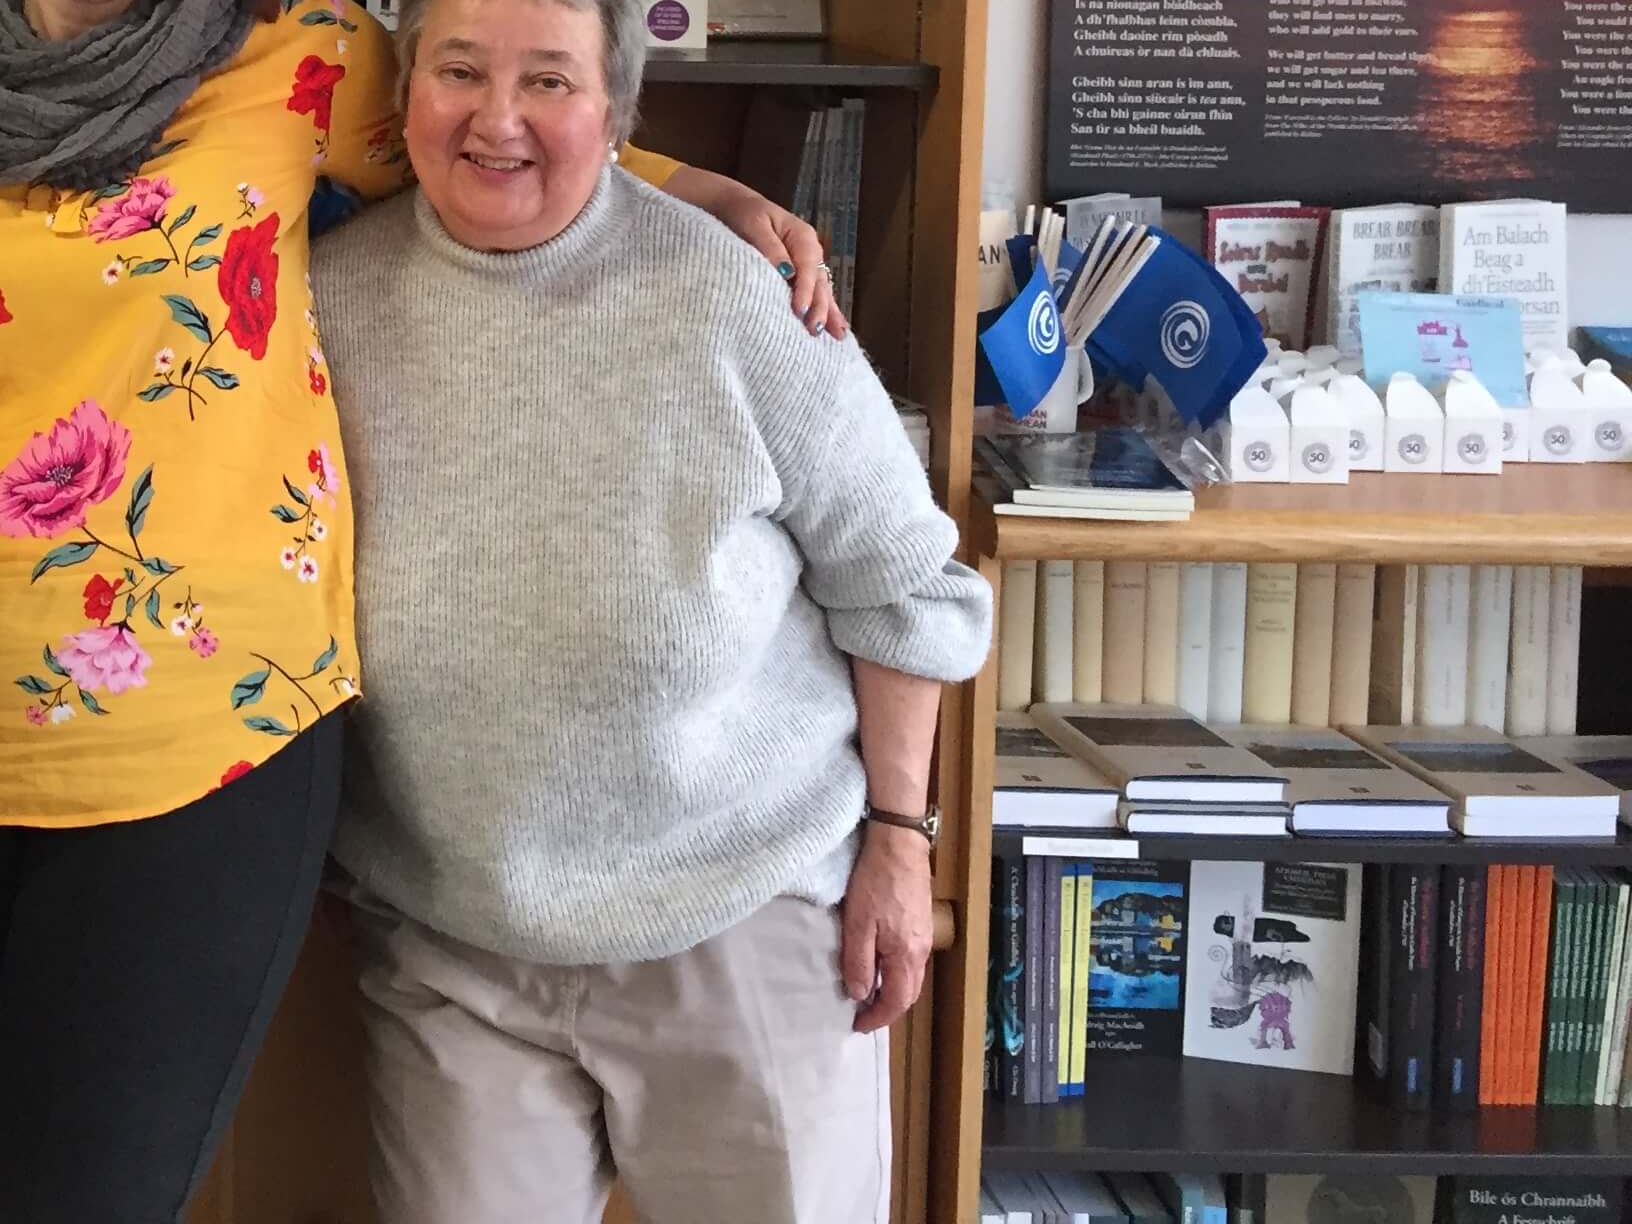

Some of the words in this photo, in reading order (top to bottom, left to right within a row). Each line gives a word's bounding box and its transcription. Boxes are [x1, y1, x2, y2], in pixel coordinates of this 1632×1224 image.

[1089, 0, 1103, 9] na
[1075, 14, 1084, 25] A
[1073, 46, 1083, 56] A
[1464, 227, 1492, 246] Am
[1496, 224, 1549, 244] Balach
[1474, 249, 1512, 273] Beag
[1516, 253, 1524, 266] a
[1251, 450, 1266, 462] 50
[1310, 452, 1325, 463] 50
[1469, 1189, 1497, 1205] Bile
[1521, 1192, 1606, 1208] Chrannaibh
